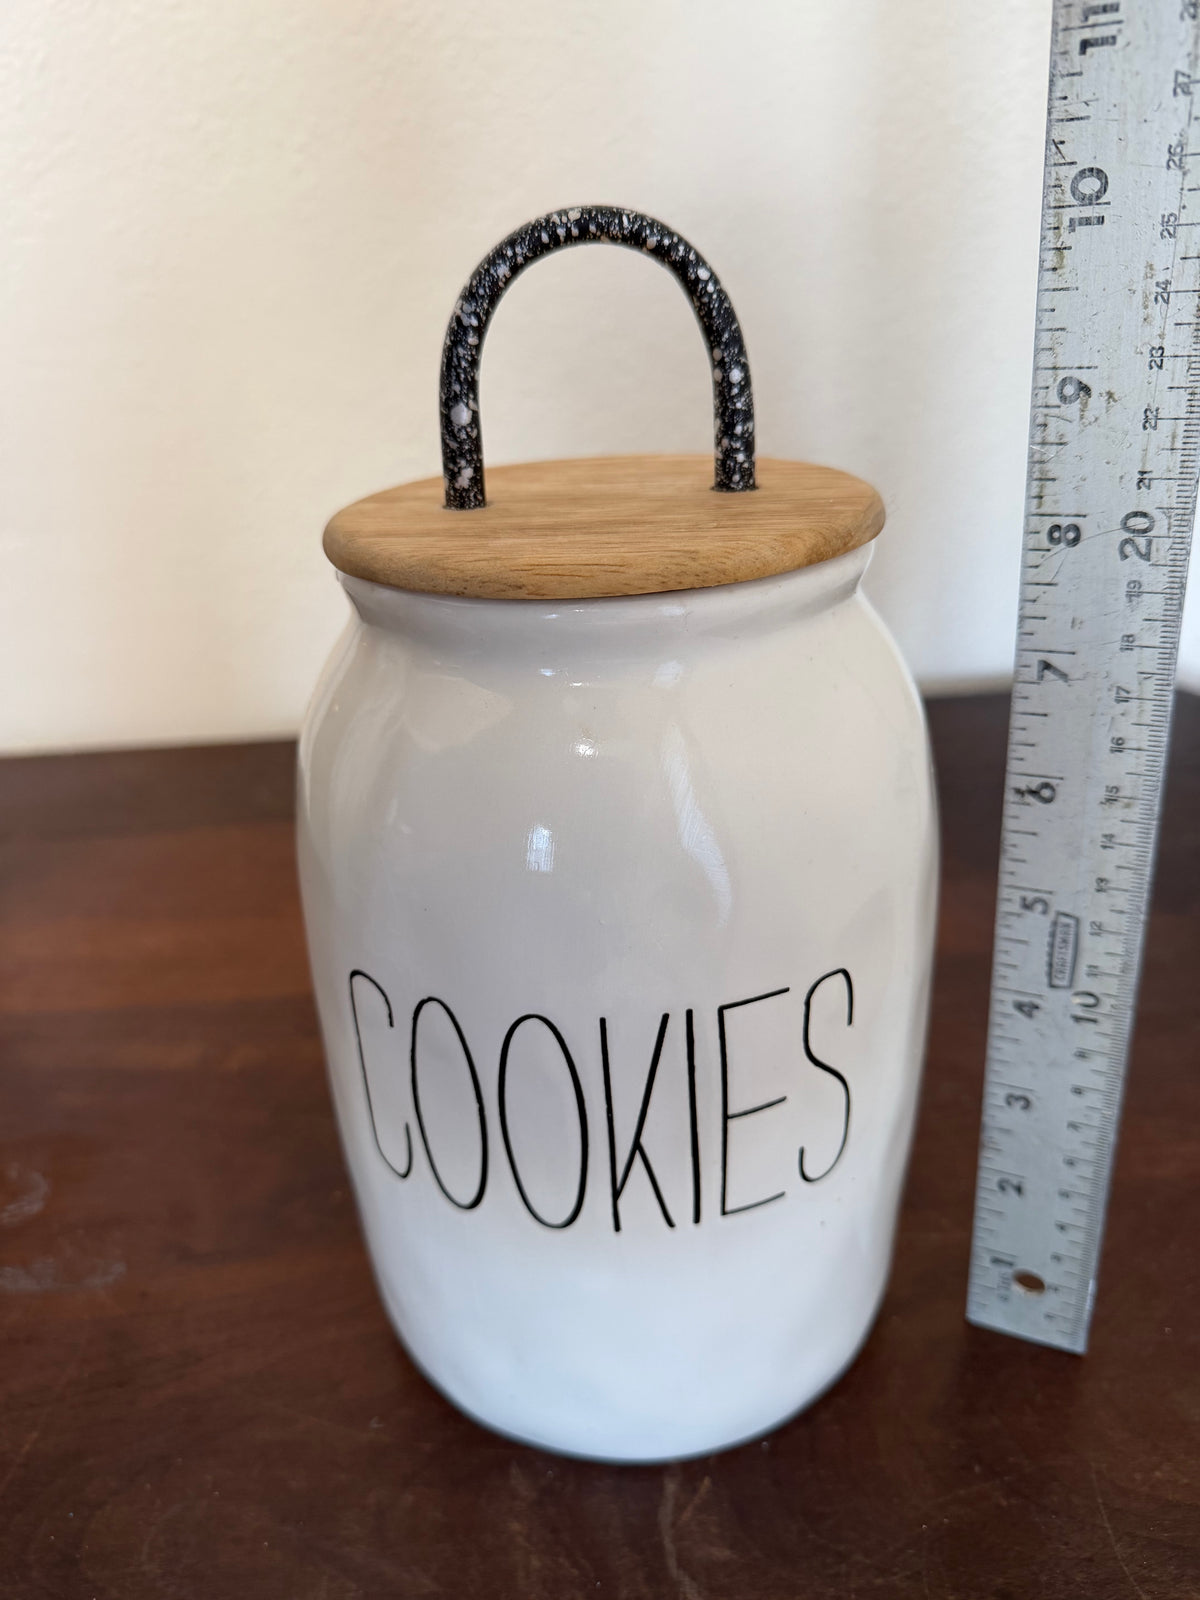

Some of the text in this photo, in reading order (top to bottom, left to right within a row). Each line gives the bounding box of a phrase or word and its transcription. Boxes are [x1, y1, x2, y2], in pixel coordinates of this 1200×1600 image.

[1079, 3, 1120, 55] 11
[1172, 70, 1192, 98] 27
[1167, 143, 1184, 171] 26
[1069, 167, 1109, 233] 10
[1160, 212, 1177, 240] 25
[1154, 280, 1172, 304] 24
[1148, 345, 1165, 371] 23
[1057, 376, 1092, 405] 9
[1142, 407, 1159, 432] 22
[1136, 470, 1152, 490] 21
[1047, 523, 1081, 548] 8
[1119, 510, 1156, 562] 20
[1126, 580, 1142, 603] 19
[1120, 634, 1135, 652] 18
[1036, 660, 1068, 683] 7
[1114, 685, 1131, 704] 17
[1110, 737, 1125, 754] 16
[1026, 782, 1056, 804] 6
[1104, 785, 1119, 805] 15
[1101, 833, 1115, 850] 14
[1095, 877, 1109, 893] 13
[1020, 895, 1050, 915] 5
[1089, 921, 1103, 937] 12
[1013, 1000, 1040, 1019] 4
[1070, 991, 1100, 1025] 10
[350, 967, 853, 1232] COOKIES
[1004, 1092, 1031, 1111] 3
[996, 1178, 1022, 1197] 2
[990, 1256, 1013, 1268] 1
